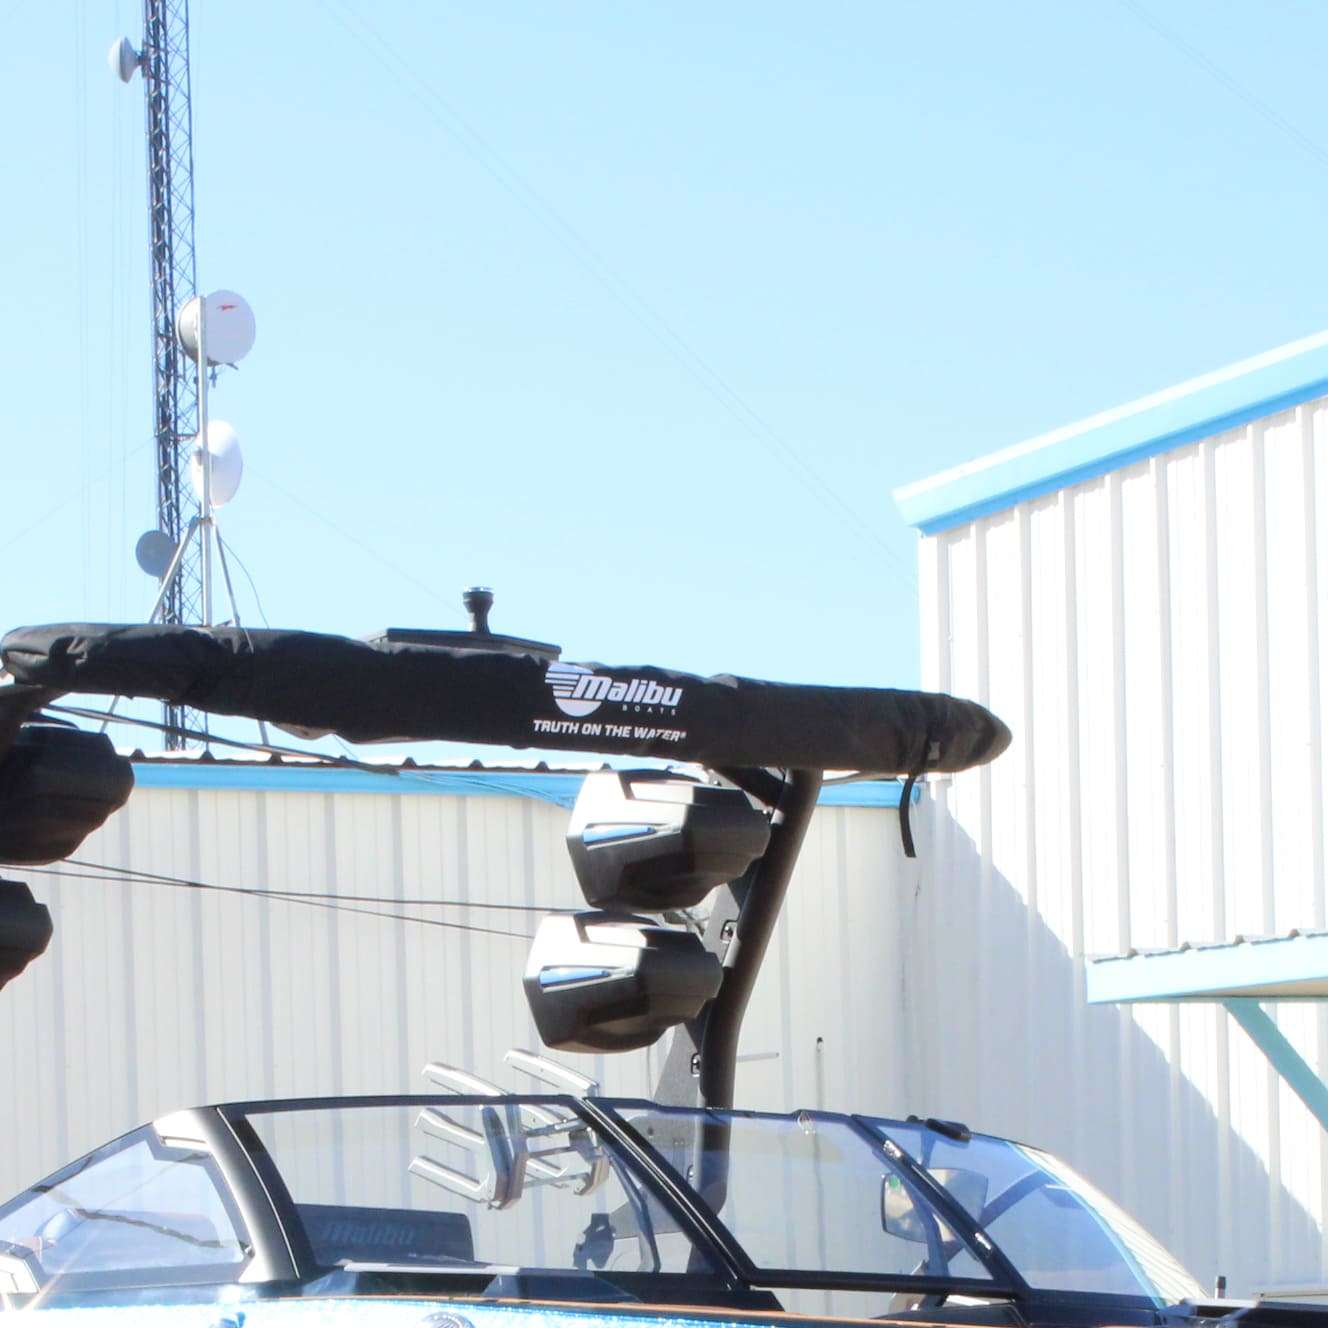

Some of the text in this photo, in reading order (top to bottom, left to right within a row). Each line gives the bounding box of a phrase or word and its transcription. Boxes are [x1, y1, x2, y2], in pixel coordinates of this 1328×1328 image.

[572, 675, 683, 706] Malibu
[533, 719, 579, 734] TRUTH
[581, 722, 604, 735] ON
[605, 724, 630, 738] THE
